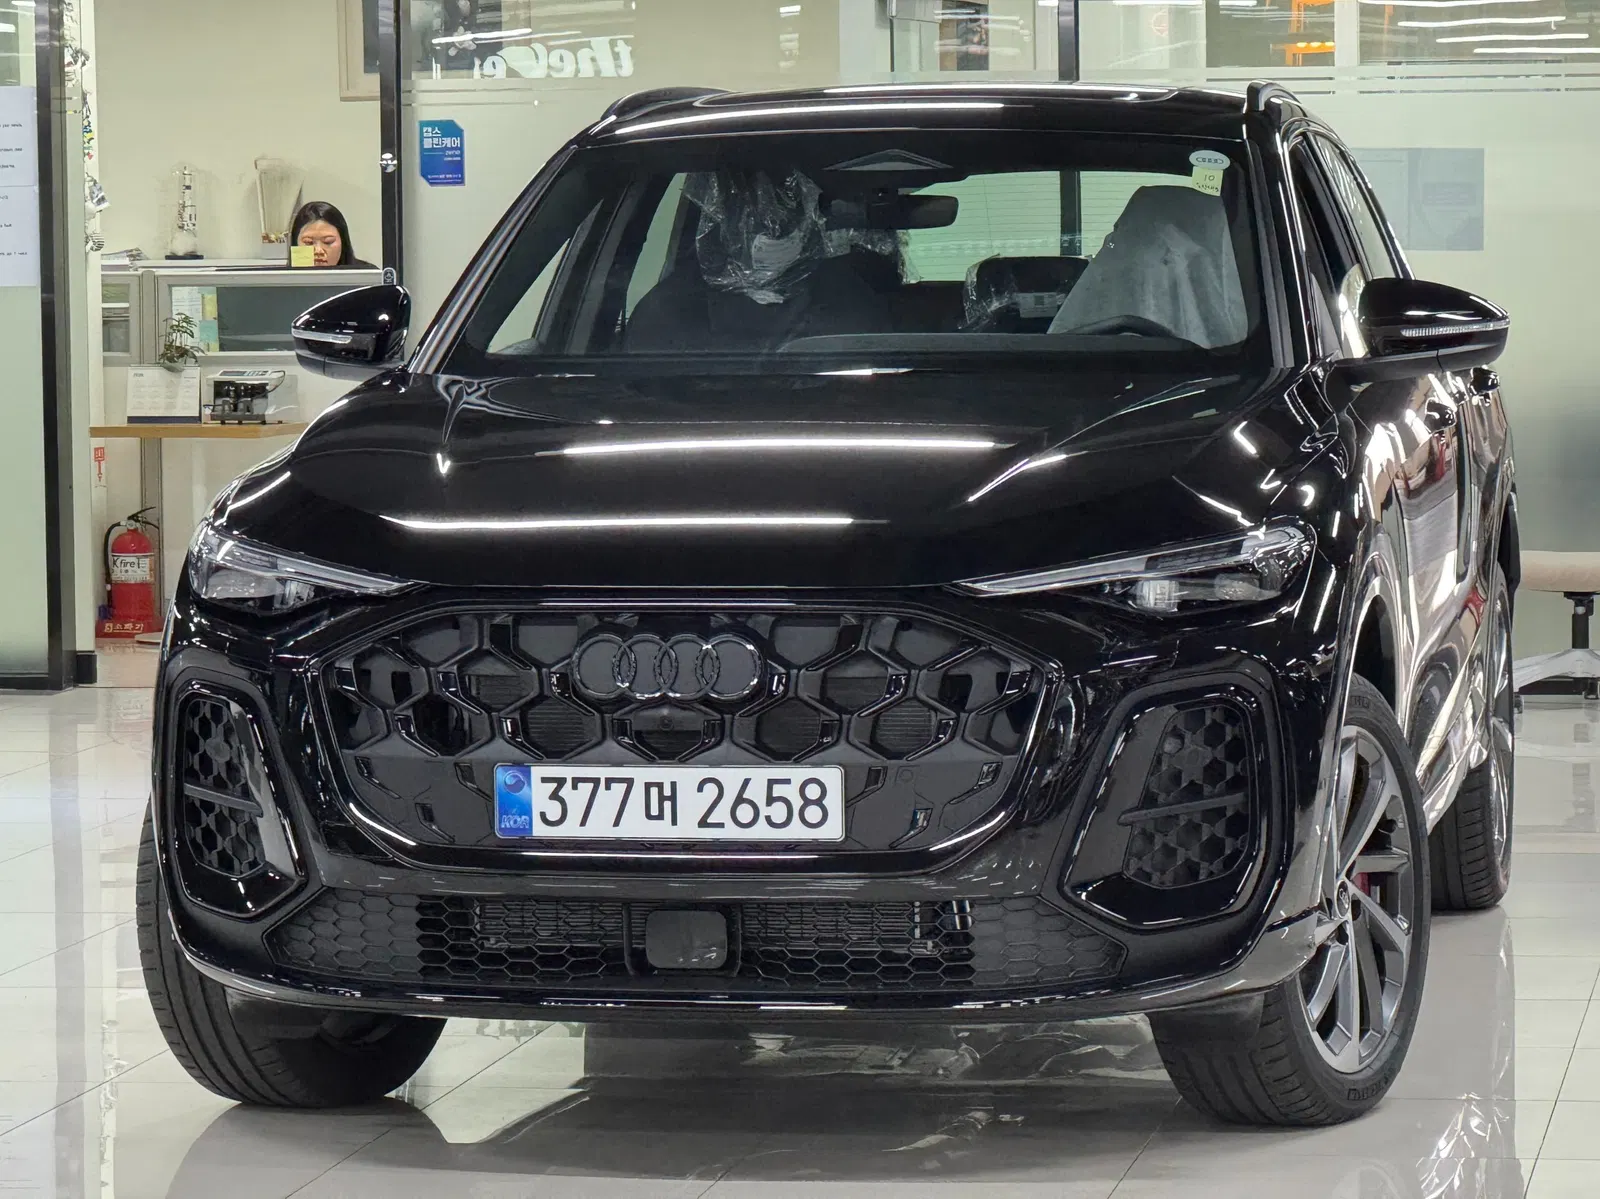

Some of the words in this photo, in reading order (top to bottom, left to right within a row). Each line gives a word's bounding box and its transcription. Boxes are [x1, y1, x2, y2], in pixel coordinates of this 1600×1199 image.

[539, 776, 678, 828] 377머
[696, 777, 829, 829] 2658
[500, 814, 530, 829] KOR
